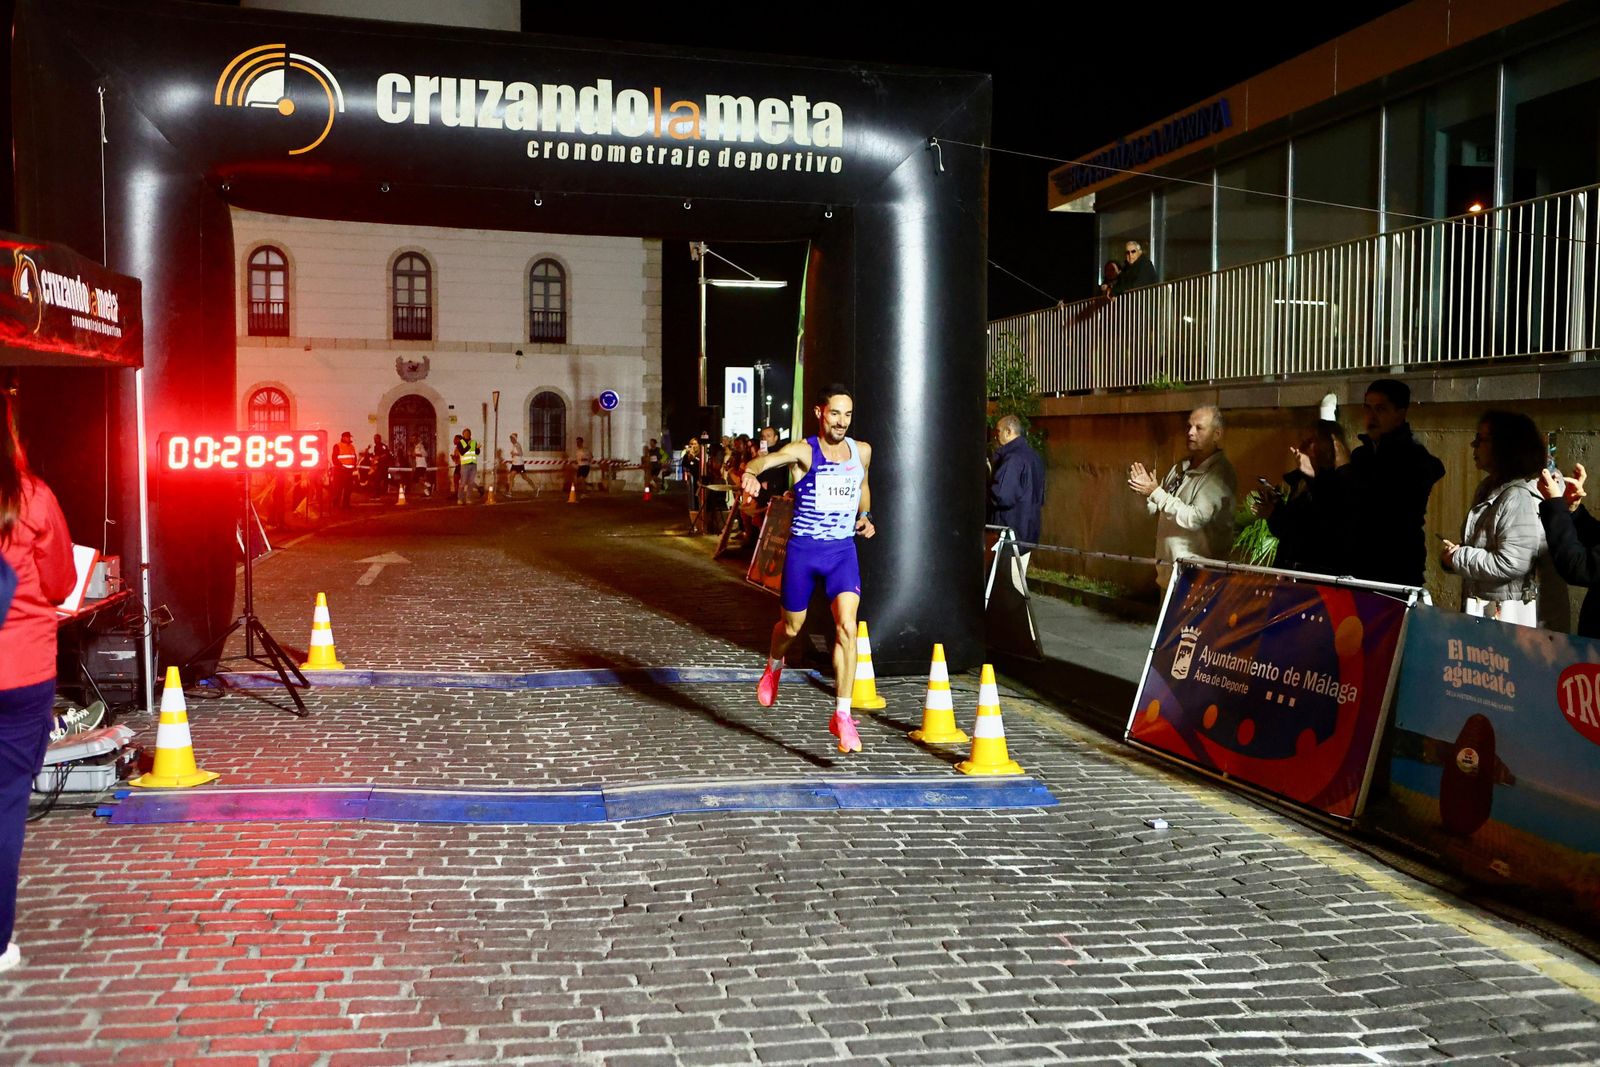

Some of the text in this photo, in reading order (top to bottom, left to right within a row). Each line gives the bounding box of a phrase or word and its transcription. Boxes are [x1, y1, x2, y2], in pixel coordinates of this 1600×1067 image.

[527, 140, 843, 174] cronometraje deportivo
[168, 435, 319, 469] 00:28:55
[828, 486, 850, 496] 1162
[1448, 638, 1510, 673] El mejor
[1194, 667, 1249, 695] Área de Deporte
[1199, 645, 1358, 704] Ayuntamiento de Málaga
[1443, 662, 1516, 698] aguacate
